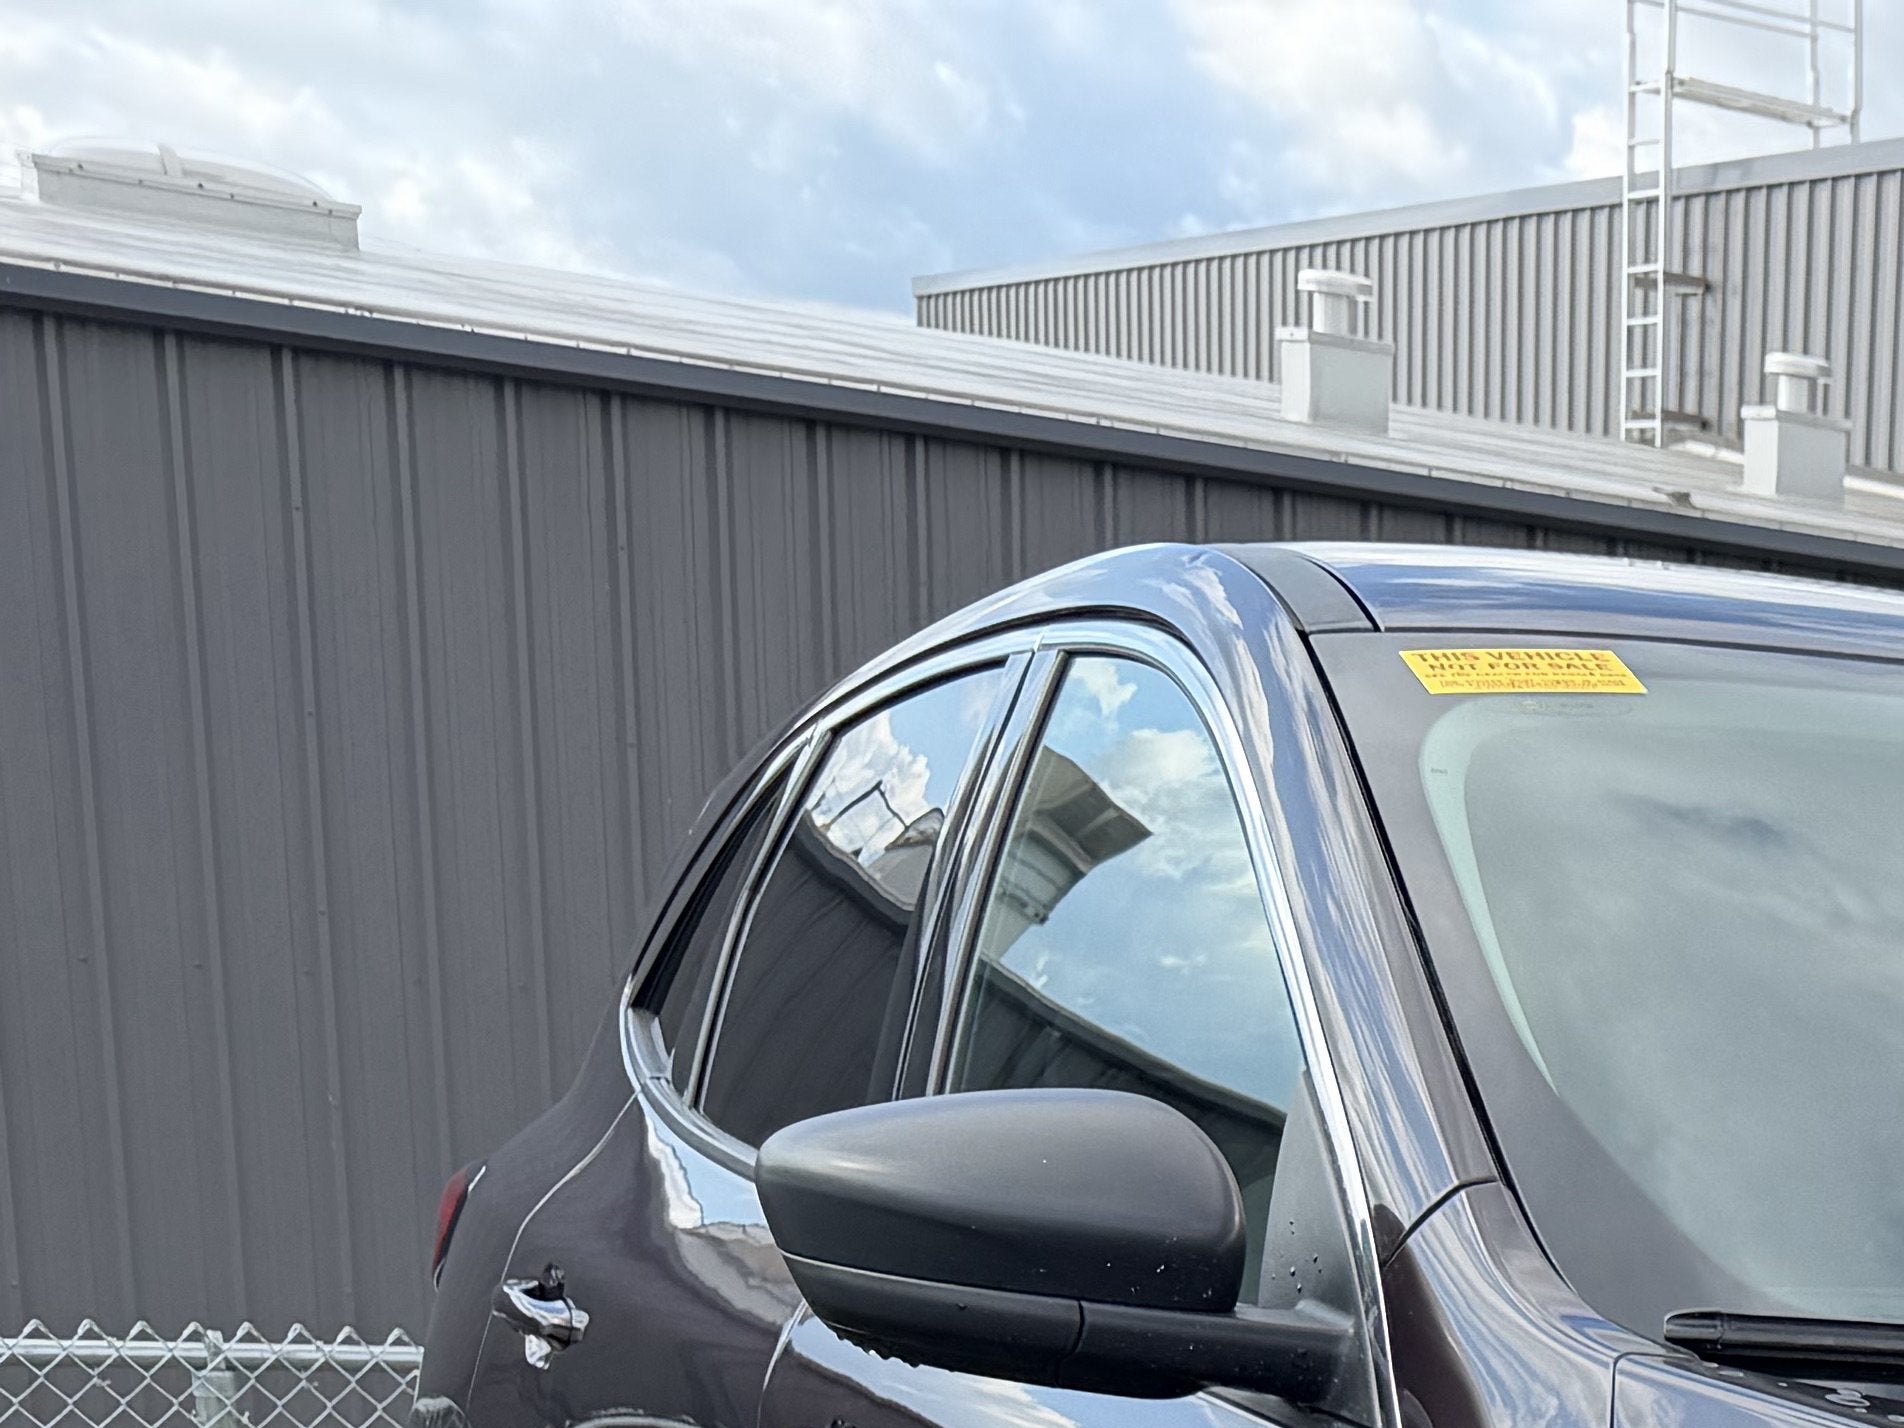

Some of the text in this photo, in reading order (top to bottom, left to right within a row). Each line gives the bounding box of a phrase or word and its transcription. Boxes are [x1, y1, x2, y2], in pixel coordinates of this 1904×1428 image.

[1411, 651, 1611, 662] THIS VEHICLE
[1428, 663, 1477, 671] NOT
[1547, 663, 1613, 671] SALE
